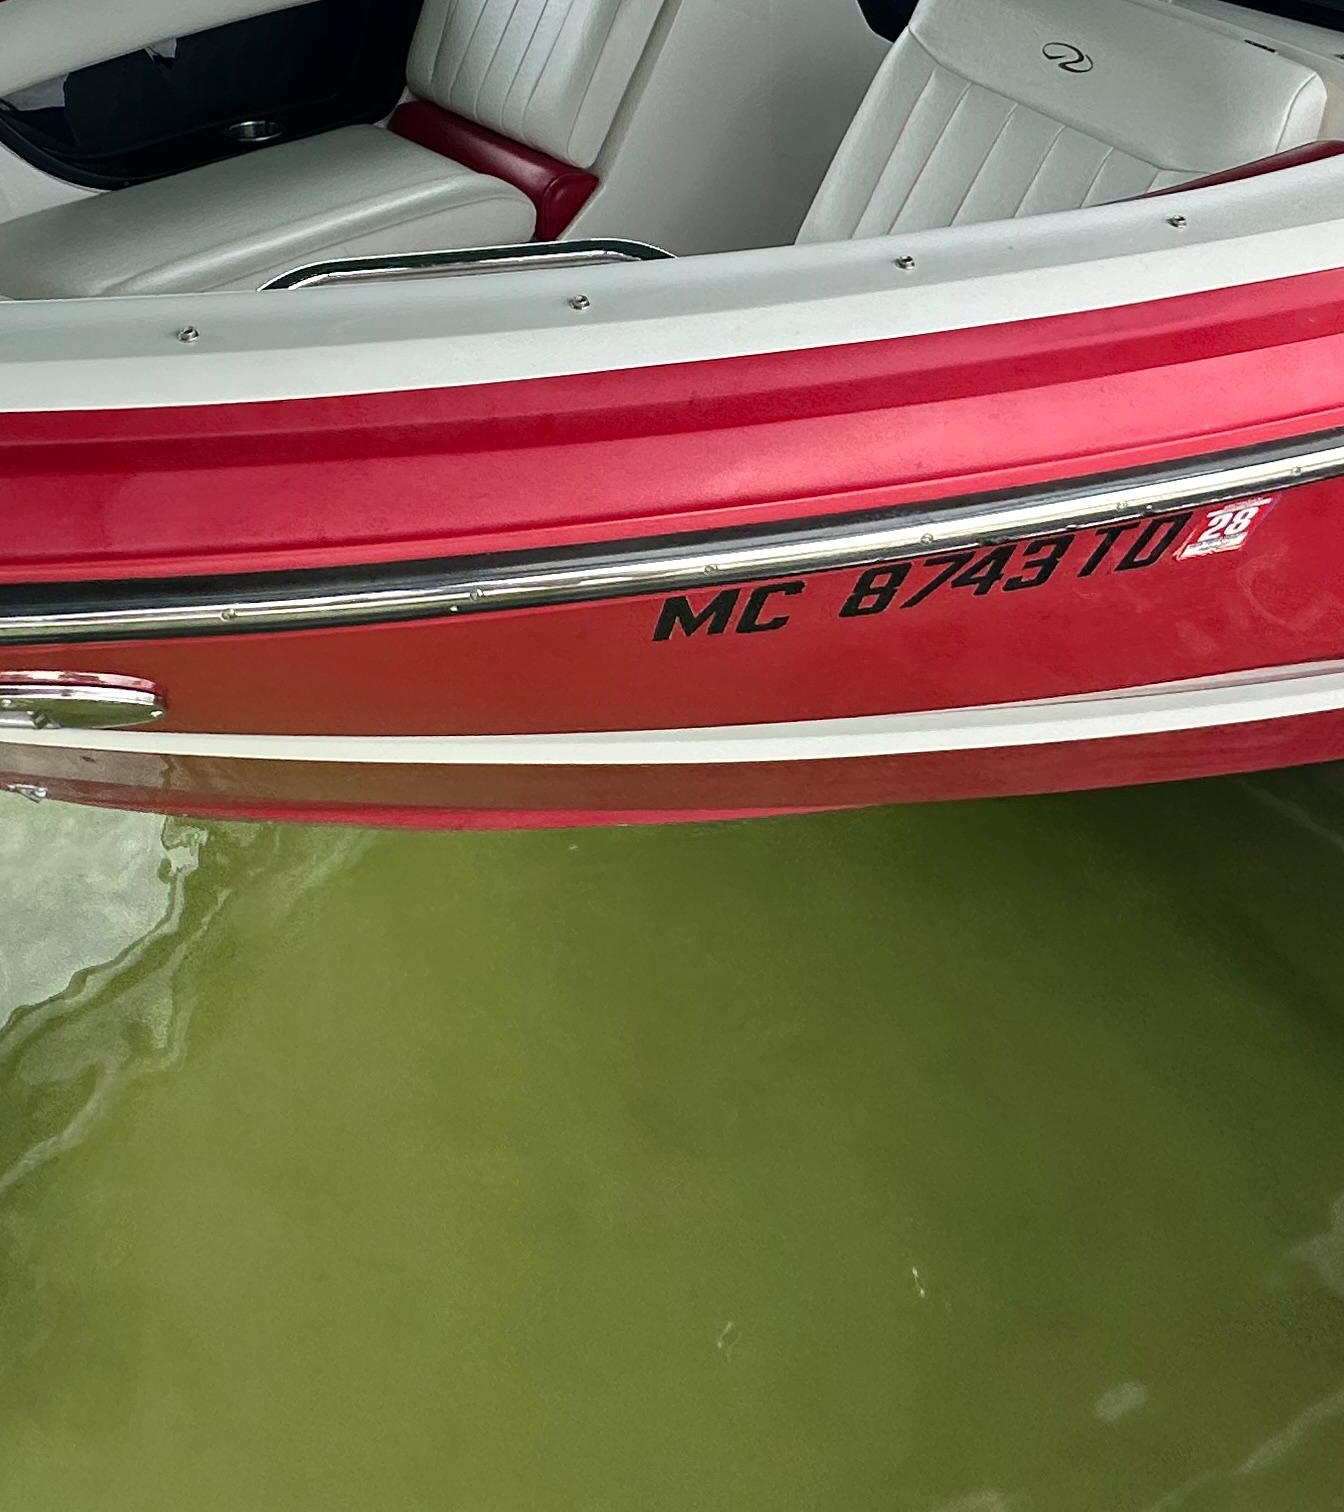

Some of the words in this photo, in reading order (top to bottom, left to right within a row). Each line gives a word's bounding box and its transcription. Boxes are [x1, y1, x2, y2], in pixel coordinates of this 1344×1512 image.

[1197, 506, 1259, 542] 28
[653, 581, 805, 641] MC
[839, 534, 1076, 617] 8743
[1077, 512, 1194, 578] TD
